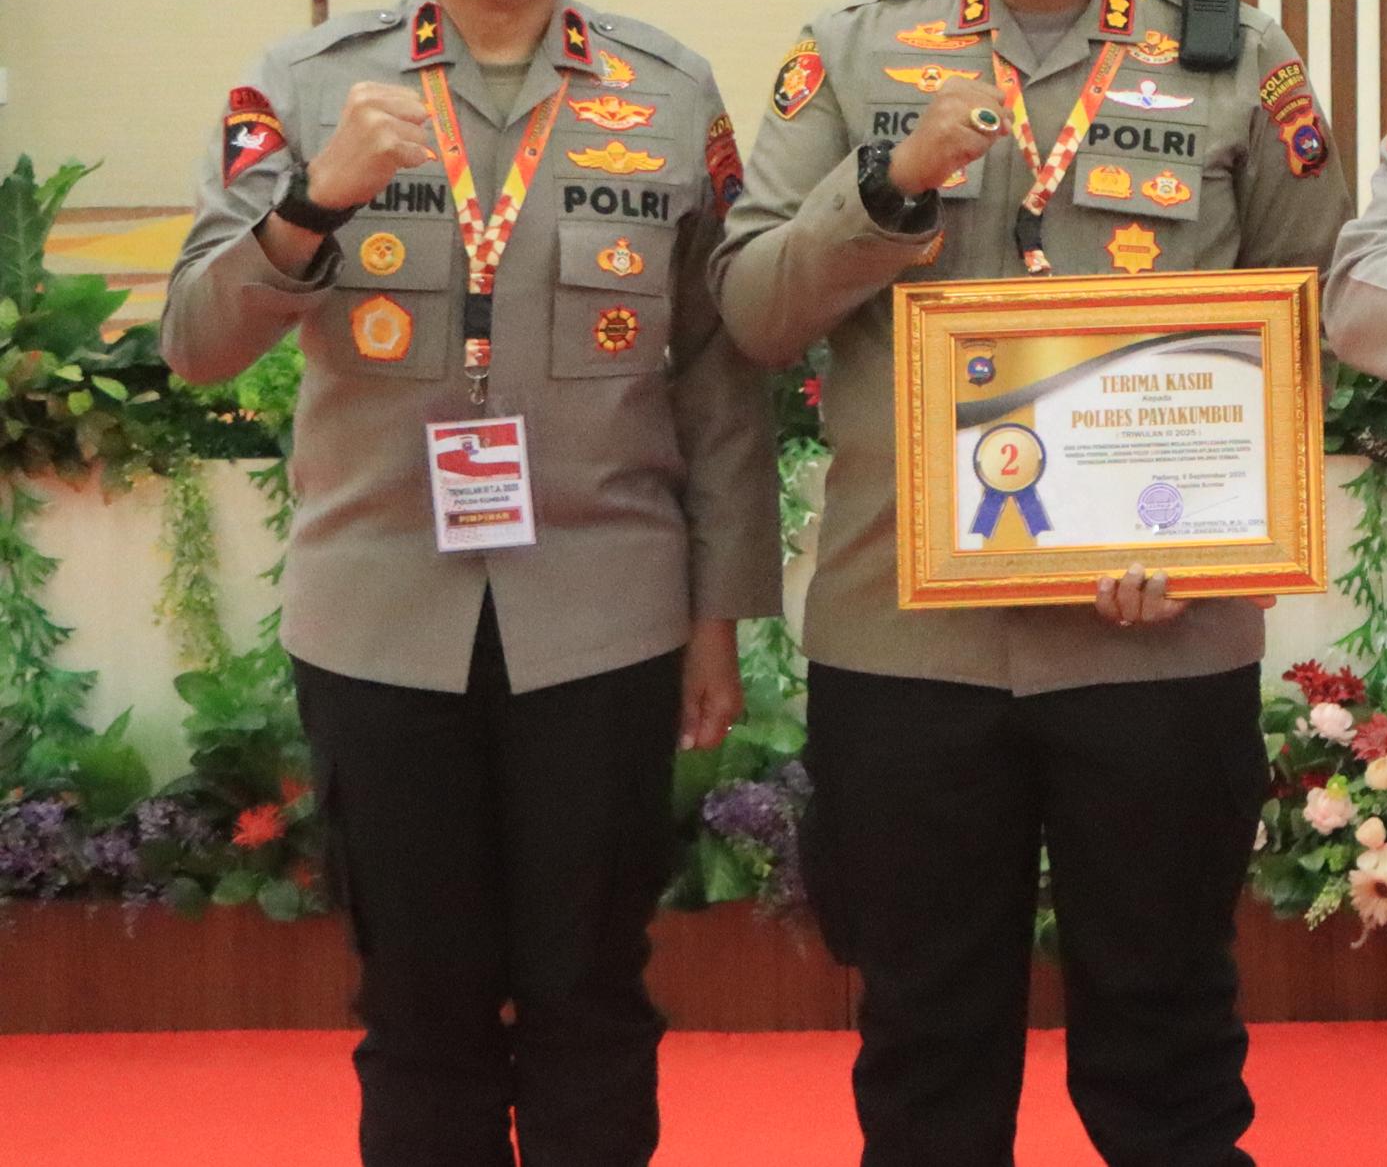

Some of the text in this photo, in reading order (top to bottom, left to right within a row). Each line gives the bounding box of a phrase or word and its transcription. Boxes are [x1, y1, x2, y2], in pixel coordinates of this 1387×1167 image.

[872, 111, 920, 136] RIC
[1088, 123, 1197, 157] POLRI
[368, 182, 446, 213] LIHIN
[563, 185, 670, 221] POLRI
[1101, 372, 1213, 394] TERIMA KASIH
[1071, 405, 1243, 429] POLRES PAYAKUMBUH
[999, 443, 1020, 476] 2
